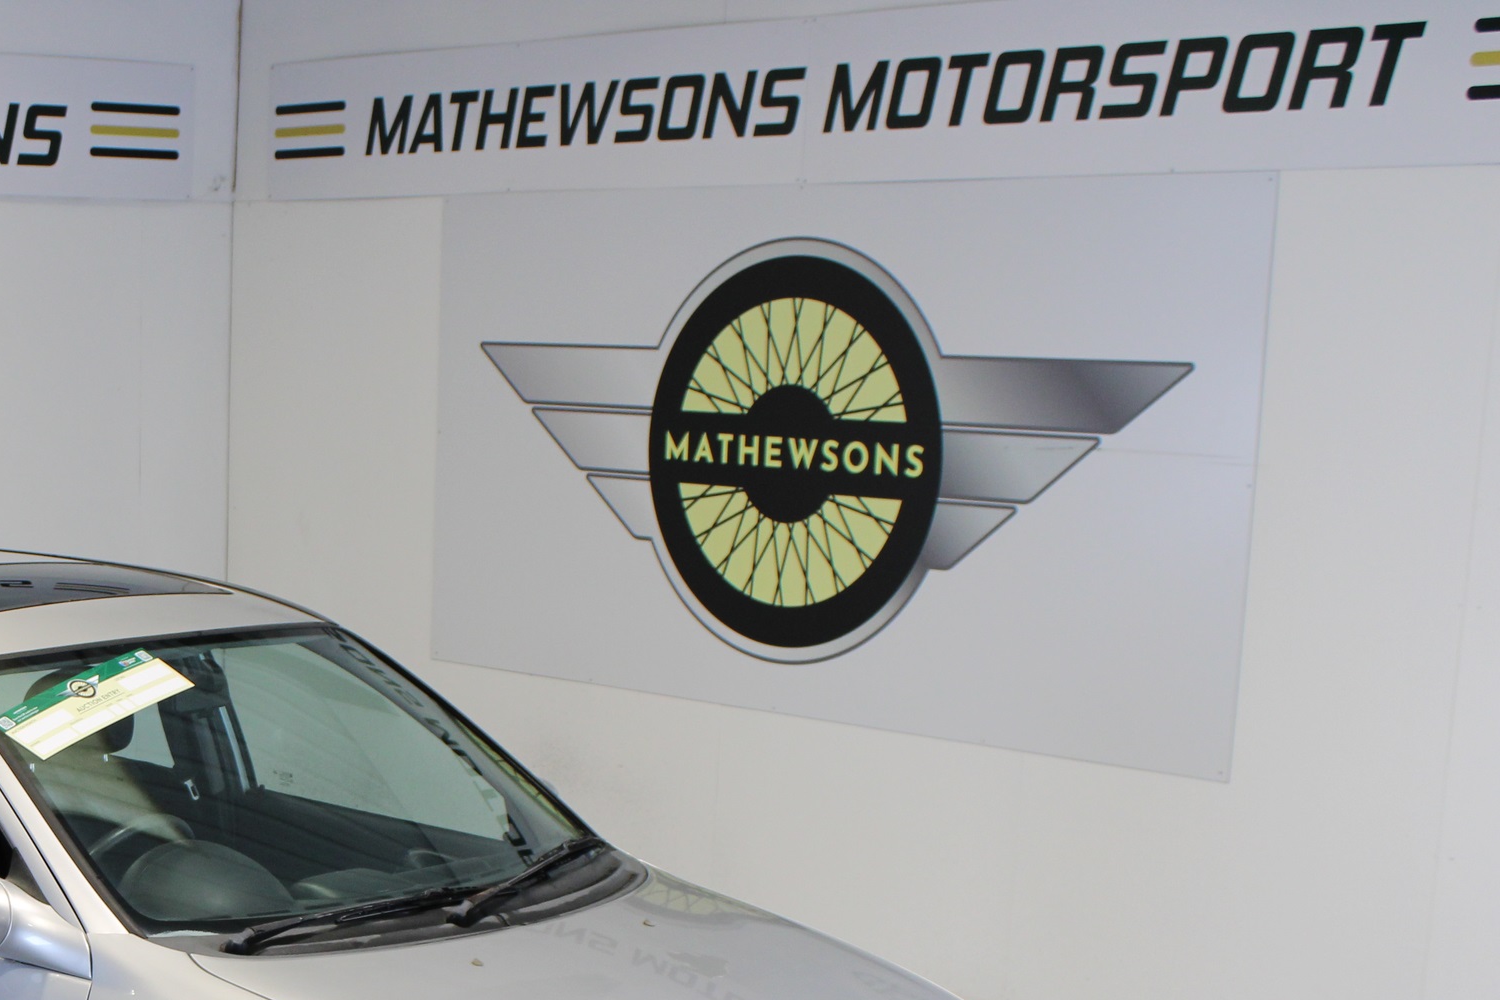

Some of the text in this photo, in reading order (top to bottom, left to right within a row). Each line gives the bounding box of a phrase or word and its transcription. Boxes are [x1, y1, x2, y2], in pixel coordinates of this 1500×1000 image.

[364, 20, 1428, 157] MATHEWSONS MOTORSPORT
[664, 429, 926, 479] MATHEWSONS
[101, 689, 122, 700] ENTRY
